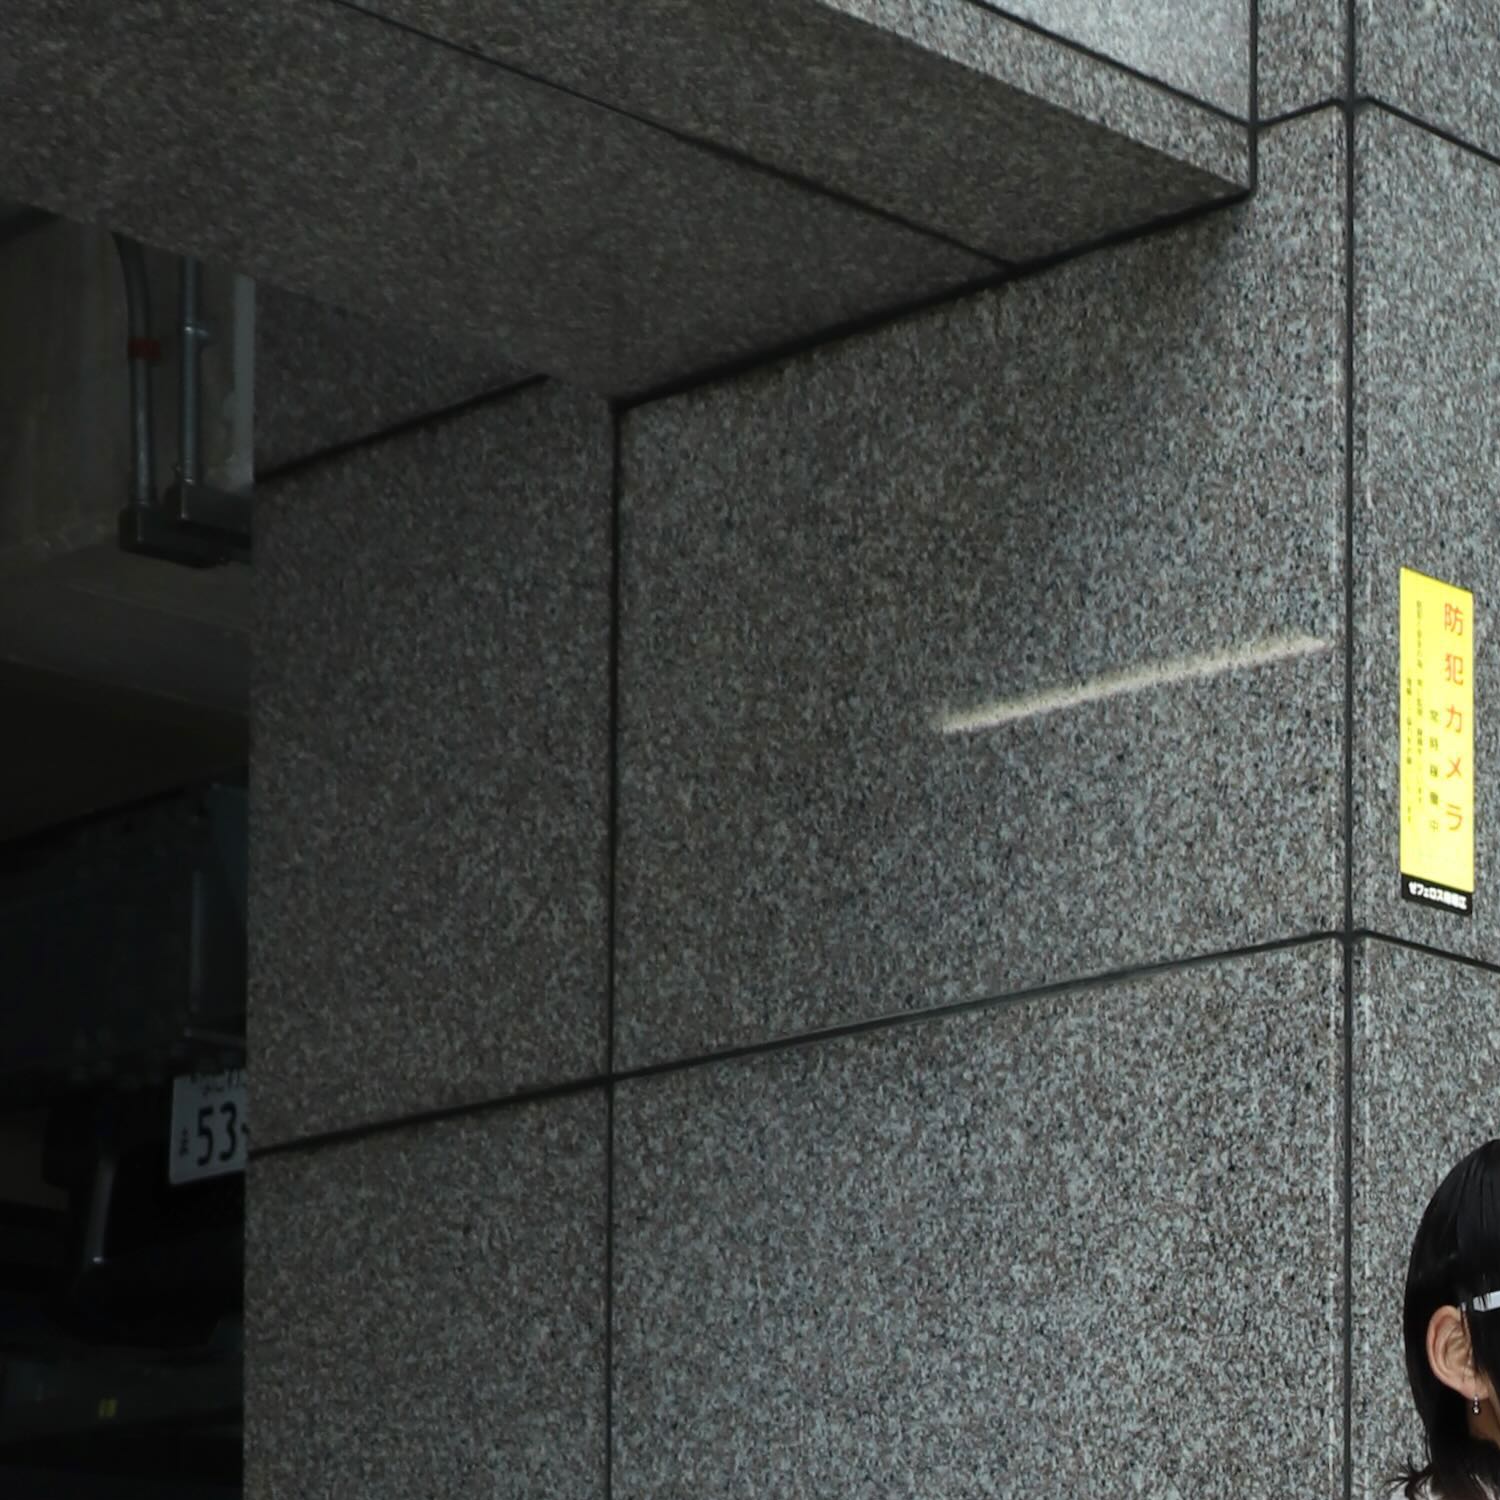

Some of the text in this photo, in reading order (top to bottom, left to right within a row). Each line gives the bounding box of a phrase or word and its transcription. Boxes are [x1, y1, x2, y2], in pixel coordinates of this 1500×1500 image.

[1443, 602, 1465, 831] 防犯カメラ
